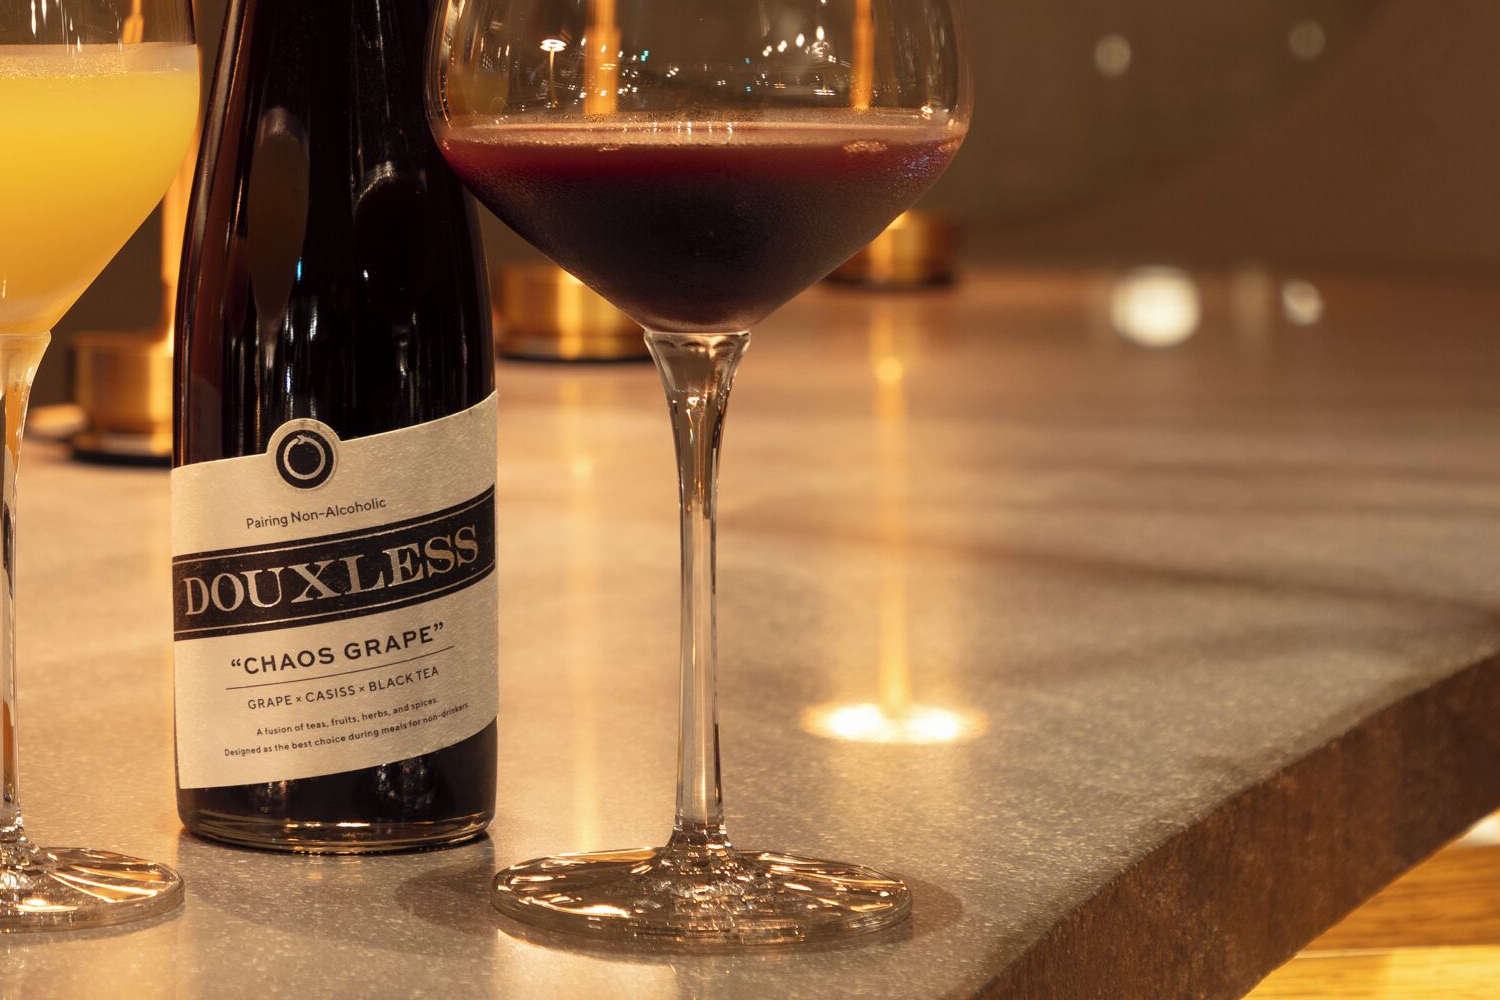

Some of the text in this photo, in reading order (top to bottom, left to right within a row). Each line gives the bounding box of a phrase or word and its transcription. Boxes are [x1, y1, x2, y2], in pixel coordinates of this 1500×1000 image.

[246, 497, 387, 529] Pairing Non-Alcoholic
[183, 525, 479, 616] DOUXLESS
[248, 695, 293, 710] GRAPE
[305, 685, 356, 703] CASISS
[369, 672, 414, 692] BLACK
[416, 666, 439, 681] TEA
[224, 747, 261, 757] Designed
[274, 743, 289, 751] the
[291, 740, 312, 749] best
[314, 735, 346, 746] choice
[348, 728, 379, 741] during
[381, 723, 407, 734] meals
[409, 719, 420, 728] for
[256, 728, 263, 736] A
[264, 726, 292, 735] fusion
[294, 724, 304, 732] of
[393, 704, 409, 714] and
